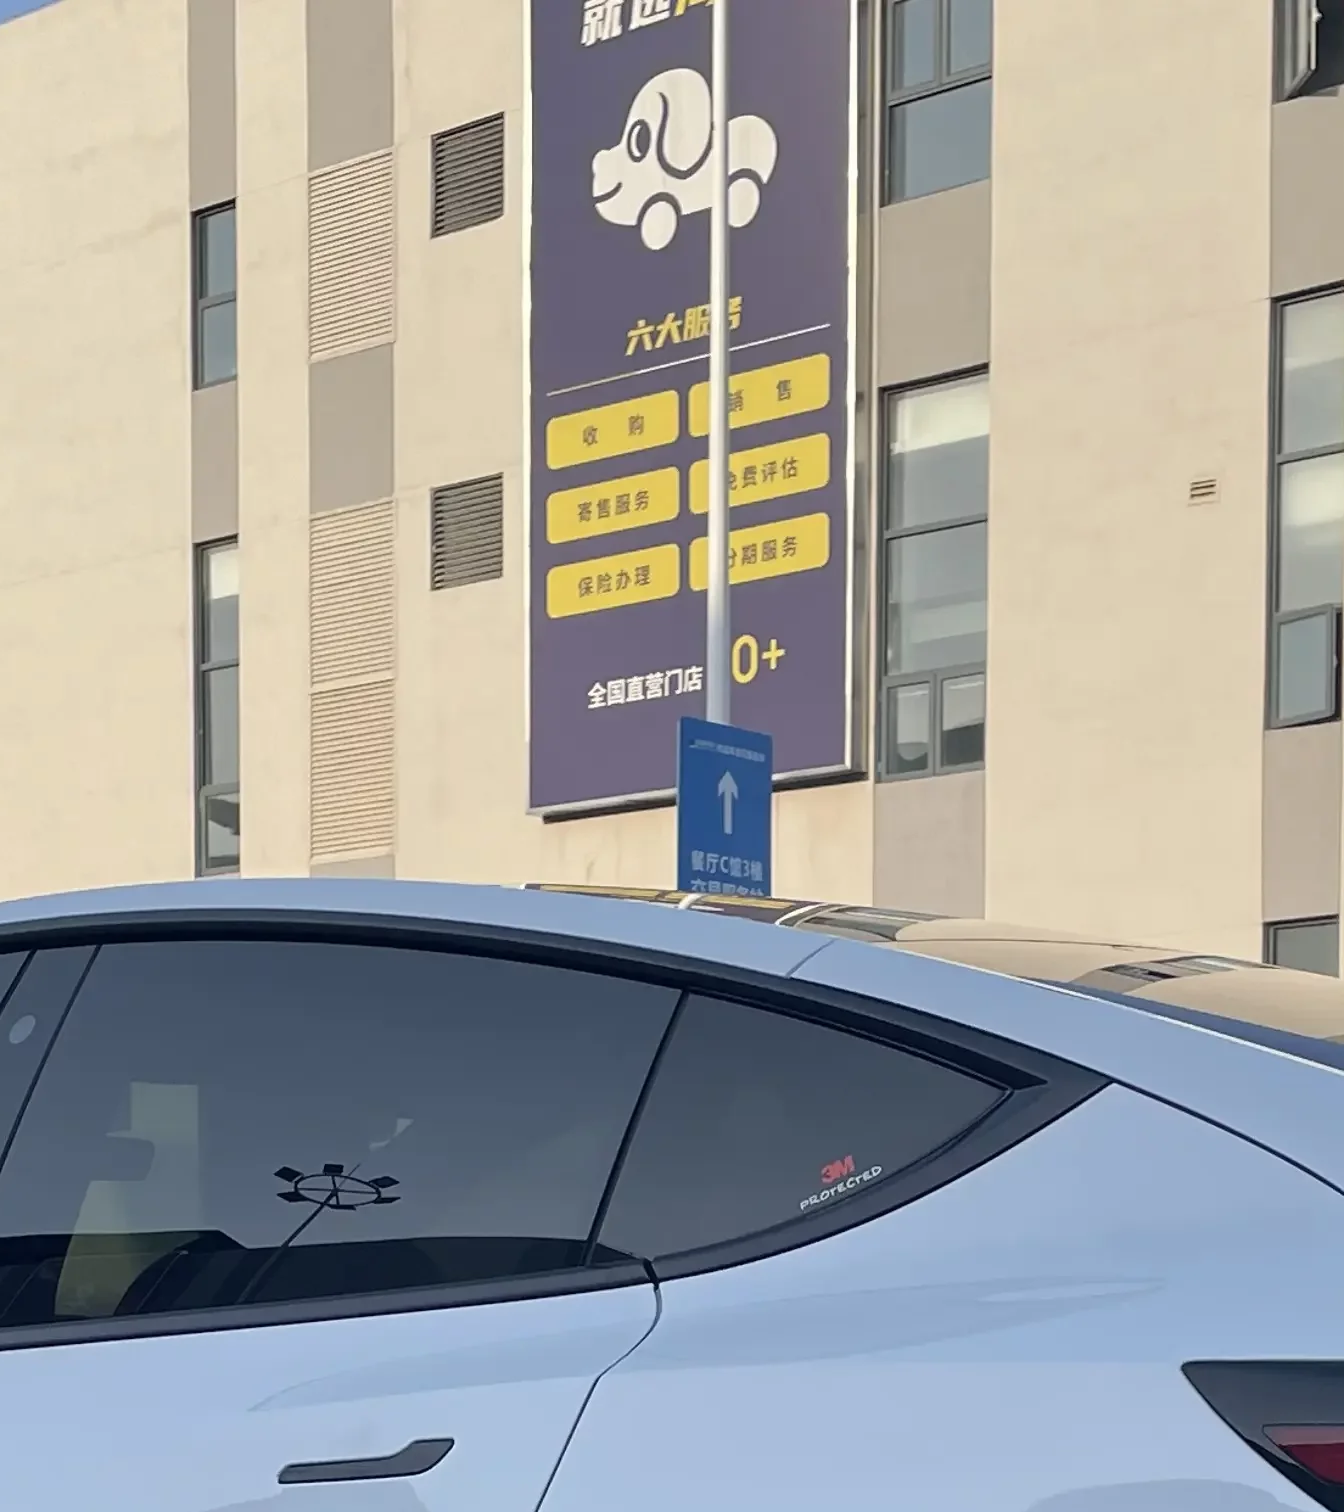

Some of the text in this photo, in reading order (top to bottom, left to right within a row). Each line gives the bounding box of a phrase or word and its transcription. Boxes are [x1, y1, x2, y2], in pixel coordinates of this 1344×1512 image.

[577, 490, 650, 523] 寄售服务
[577, 565, 651, 598] 保险办理
[587, 665, 704, 709] 全国直营门店
[821, 1155, 855, 1183] 3M
[799, 1165, 883, 1211] PROTECTED
